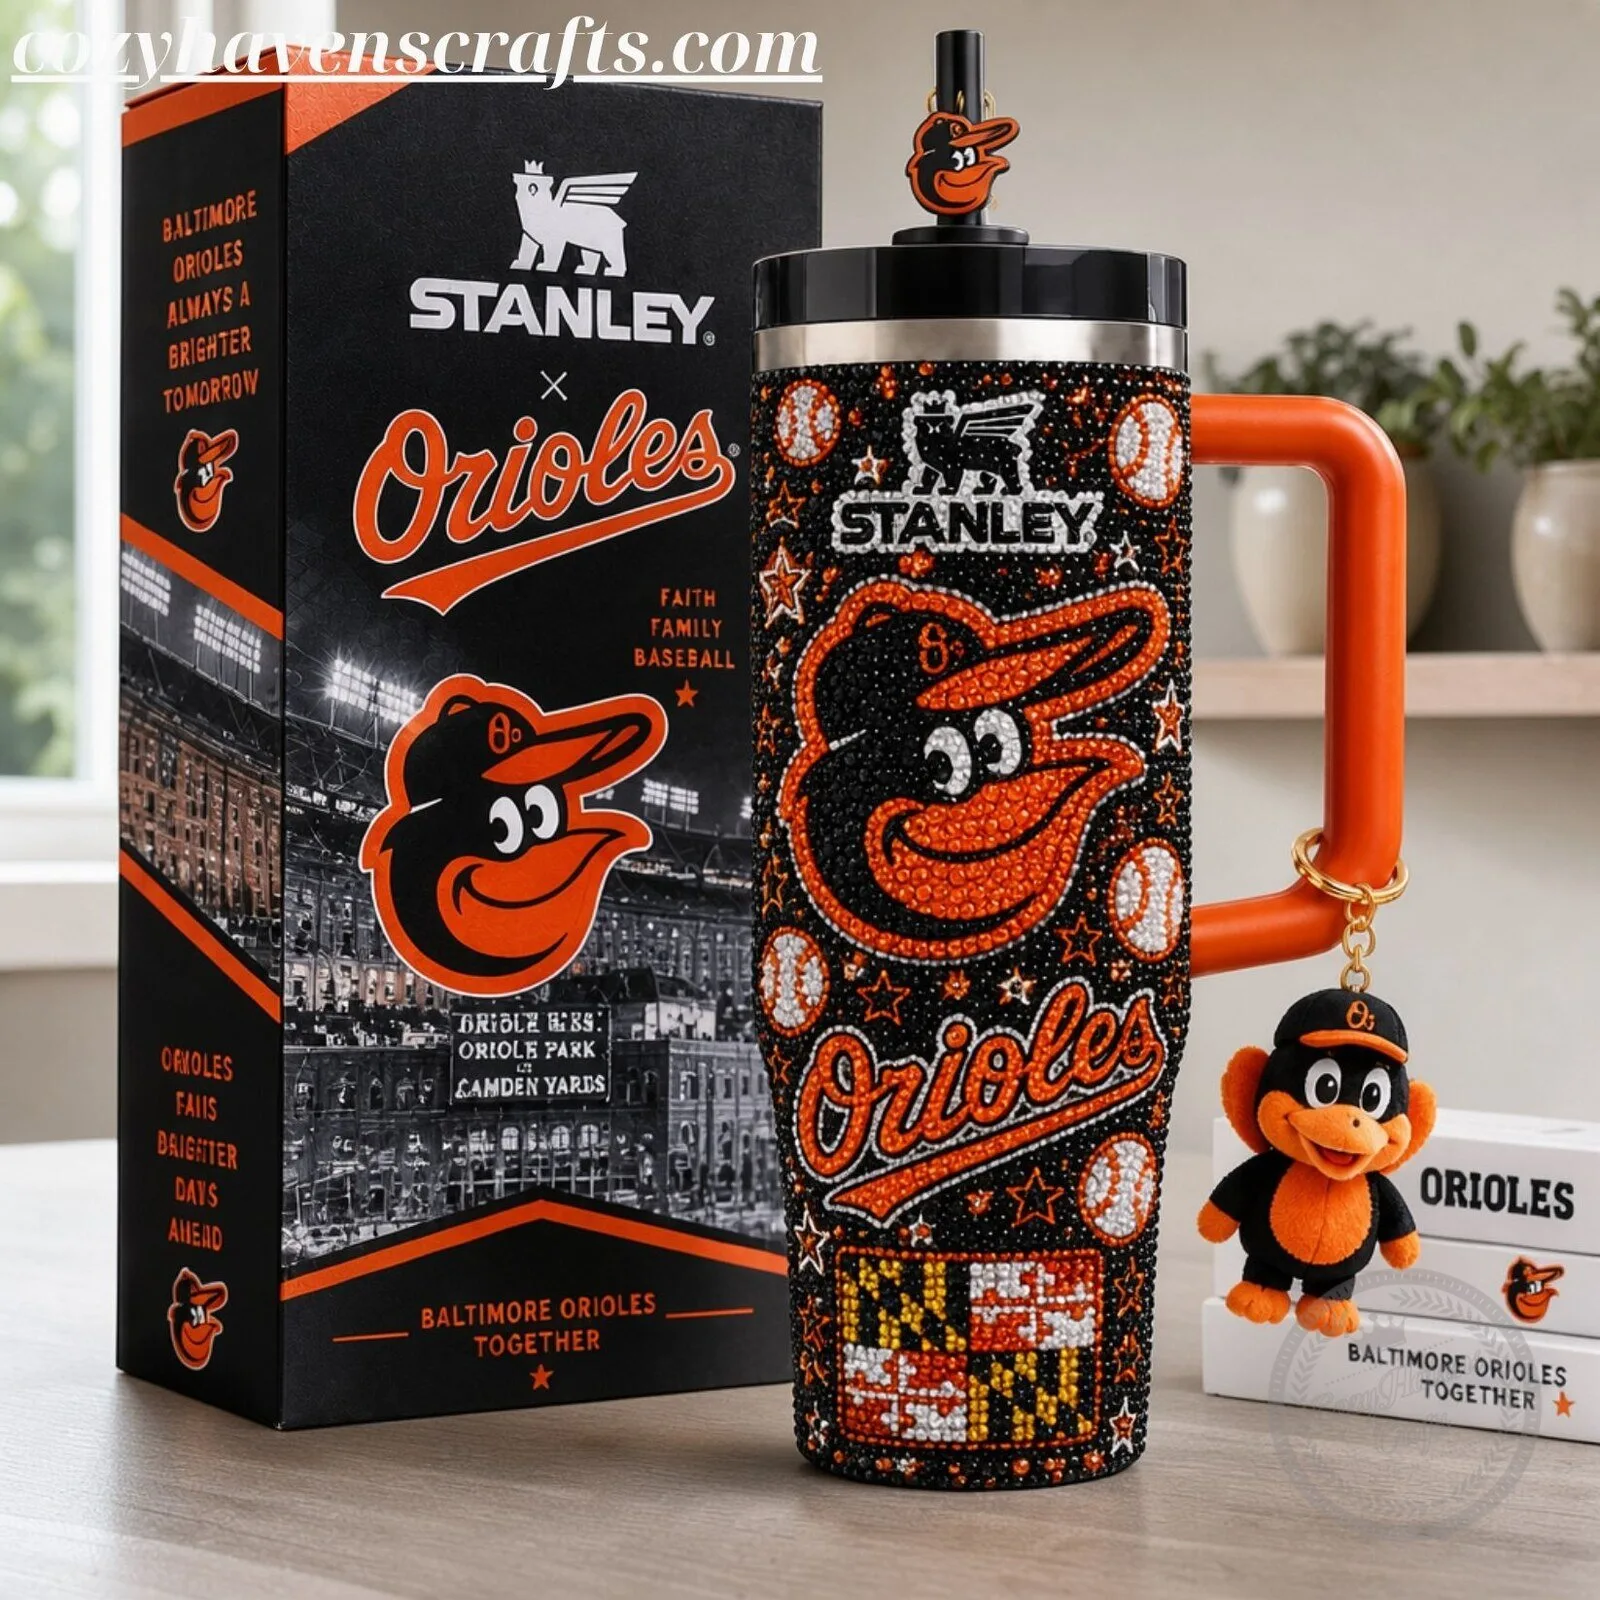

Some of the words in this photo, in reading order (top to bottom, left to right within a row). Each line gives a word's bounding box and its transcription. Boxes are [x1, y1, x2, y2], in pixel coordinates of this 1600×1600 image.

[162, 190, 257, 243] BALTIMORE
[172, 239, 244, 283] ORIOLES
[167, 286, 233, 328] ALWAYS
[239, 281, 252, 307] A
[409, 277, 715, 345] STANLEY
[167, 325, 252, 370] BRIGHTER
[163, 368, 259, 413] TOMORROW
[353, 388, 737, 565] Orioles
[836, 498, 1099, 548] STANLEY
[660, 587, 717, 606] FAITH
[650, 617, 721, 636] FAMILY
[633, 647, 734, 669] BASEBALL
[544, 1040, 596, 1060] PARK
[793, 975, 1170, 1185] Orioles
[1420, 1166, 1575, 1221] ORIOLES
[420, 1299, 552, 1329] BALTIMORE
[559, 1291, 656, 1320] ORIOLES
[474, 1328, 601, 1357] TOGETHER
[1348, 1343, 1466, 1375] BALTIMORE
[1475, 1358, 1567, 1388] ORIOLES
[1422, 1380, 1536, 1410] TOGETHER
